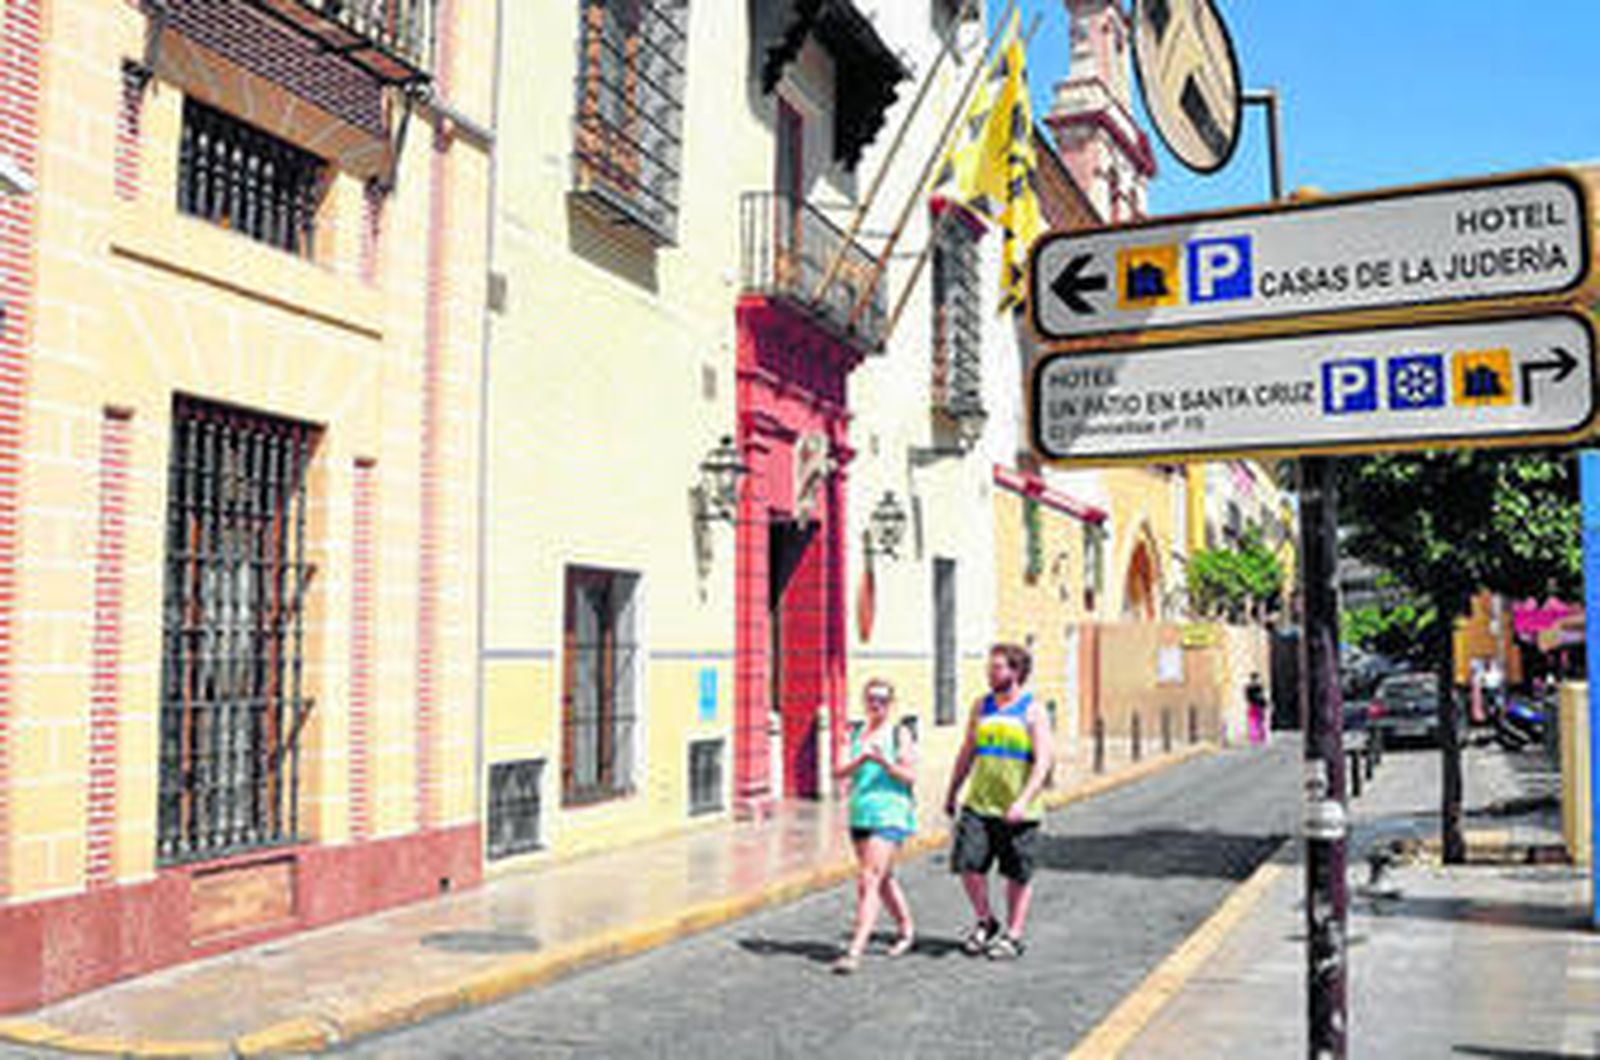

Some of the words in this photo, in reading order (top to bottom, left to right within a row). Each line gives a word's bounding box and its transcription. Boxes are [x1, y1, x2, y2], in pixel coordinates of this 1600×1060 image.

[1456, 201, 1565, 235] HOTEL
[1259, 264, 1350, 299] CASAS
[1356, 260, 1392, 290] DE
[1402, 257, 1438, 284] LA
[1444, 240, 1567, 281] JUDERÍA
[1050, 368, 1117, 389] HOTEL
[1147, 390, 1175, 414] EN
[1180, 384, 1250, 411] SANTA
[1256, 381, 1315, 407] CRUZ
